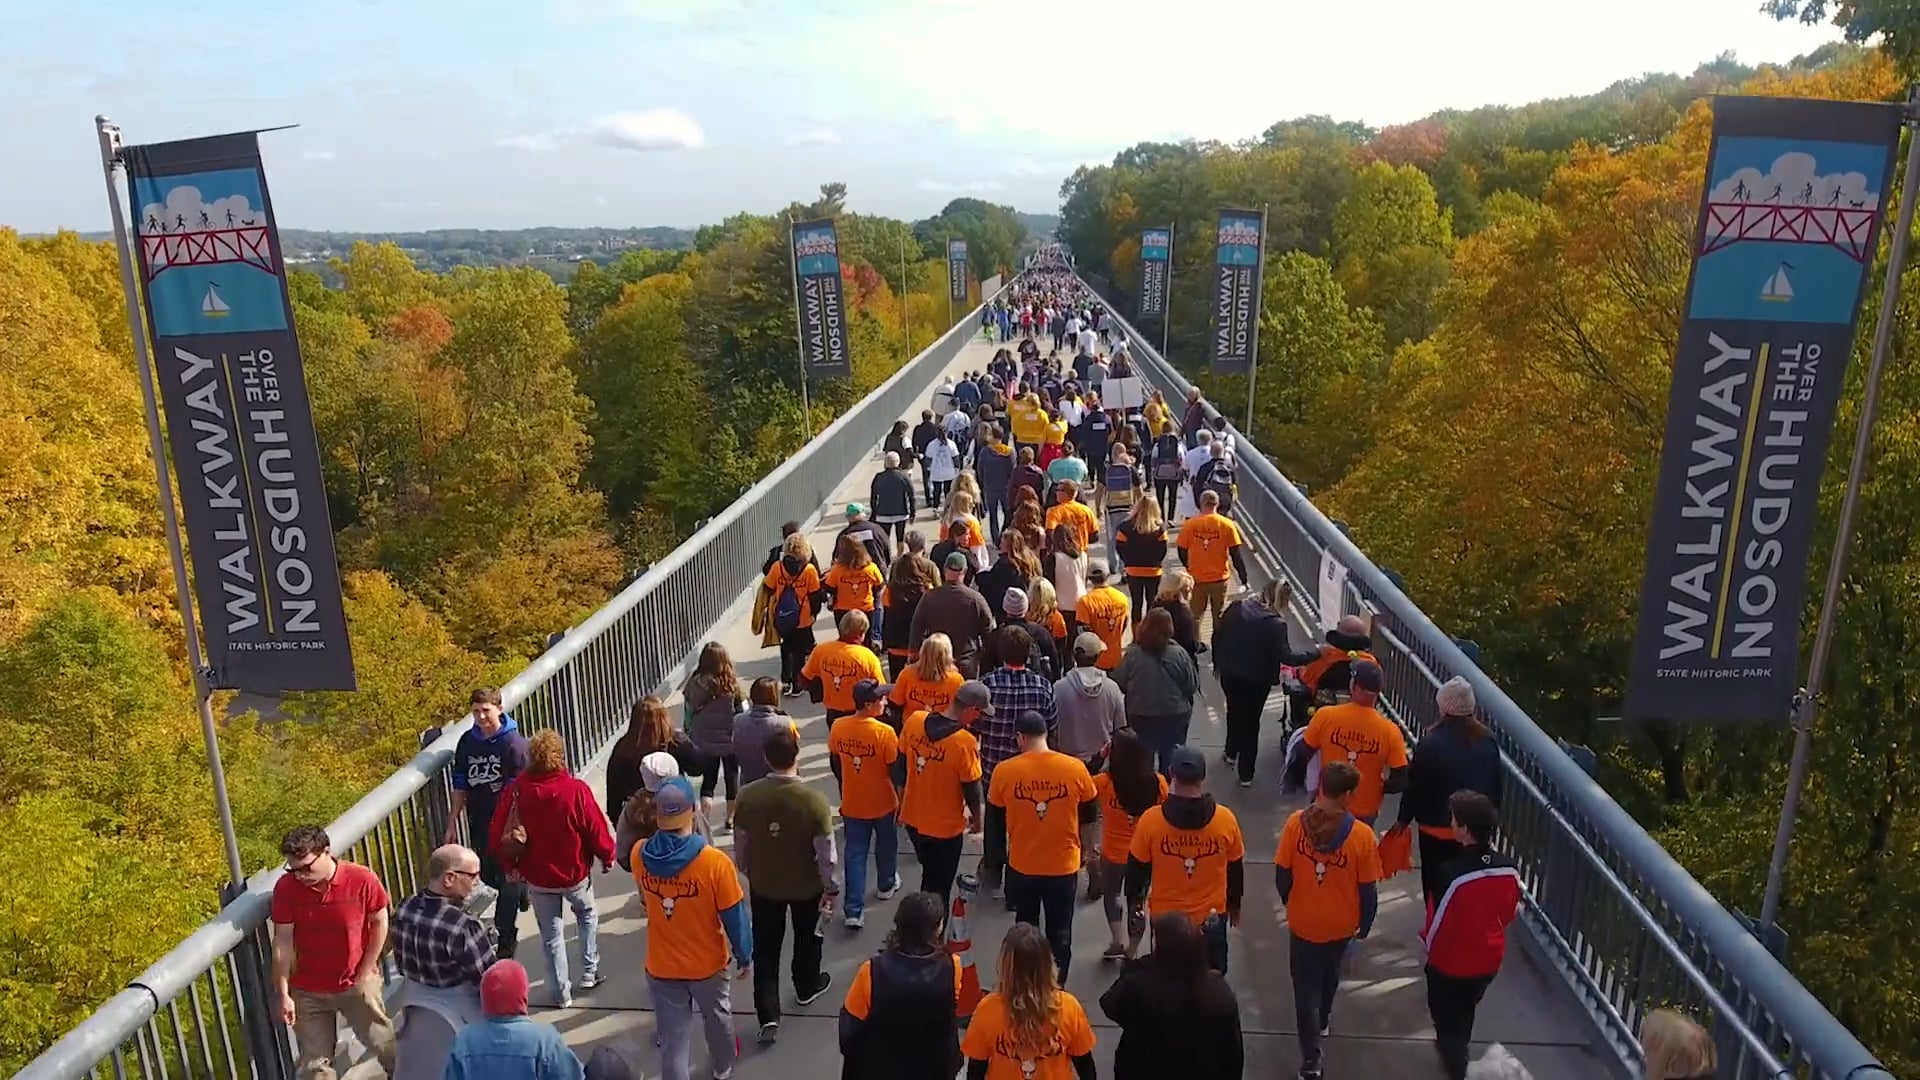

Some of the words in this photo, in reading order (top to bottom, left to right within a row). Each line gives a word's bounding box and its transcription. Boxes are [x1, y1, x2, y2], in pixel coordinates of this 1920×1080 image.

[1143, 260, 1153, 311] WALKWAY
[1153, 273, 1163, 311] HUDSON
[1217, 267, 1233, 355] WALKWAY
[804, 277, 824, 362] WALKWAY
[825, 294, 842, 361] HUDSON
[1235, 286, 1250, 355] HUDSON
[239, 350, 263, 402] THE
[258, 349, 280, 402] OVER
[1773, 344, 1802, 400] THE
[1798, 344, 1822, 402] OVER
[174, 346, 259, 634] WALKWAY
[250, 409, 320, 633] HUDSON
[1659, 331, 1752, 660] WALKWAY
[1731, 411, 1808, 659] HUDSON
[301, 641, 326, 650] PARK
[1656, 668, 1688, 678] STATE
[1691, 668, 1740, 678] HISTORIC
[1743, 668, 1772, 677] PARK
